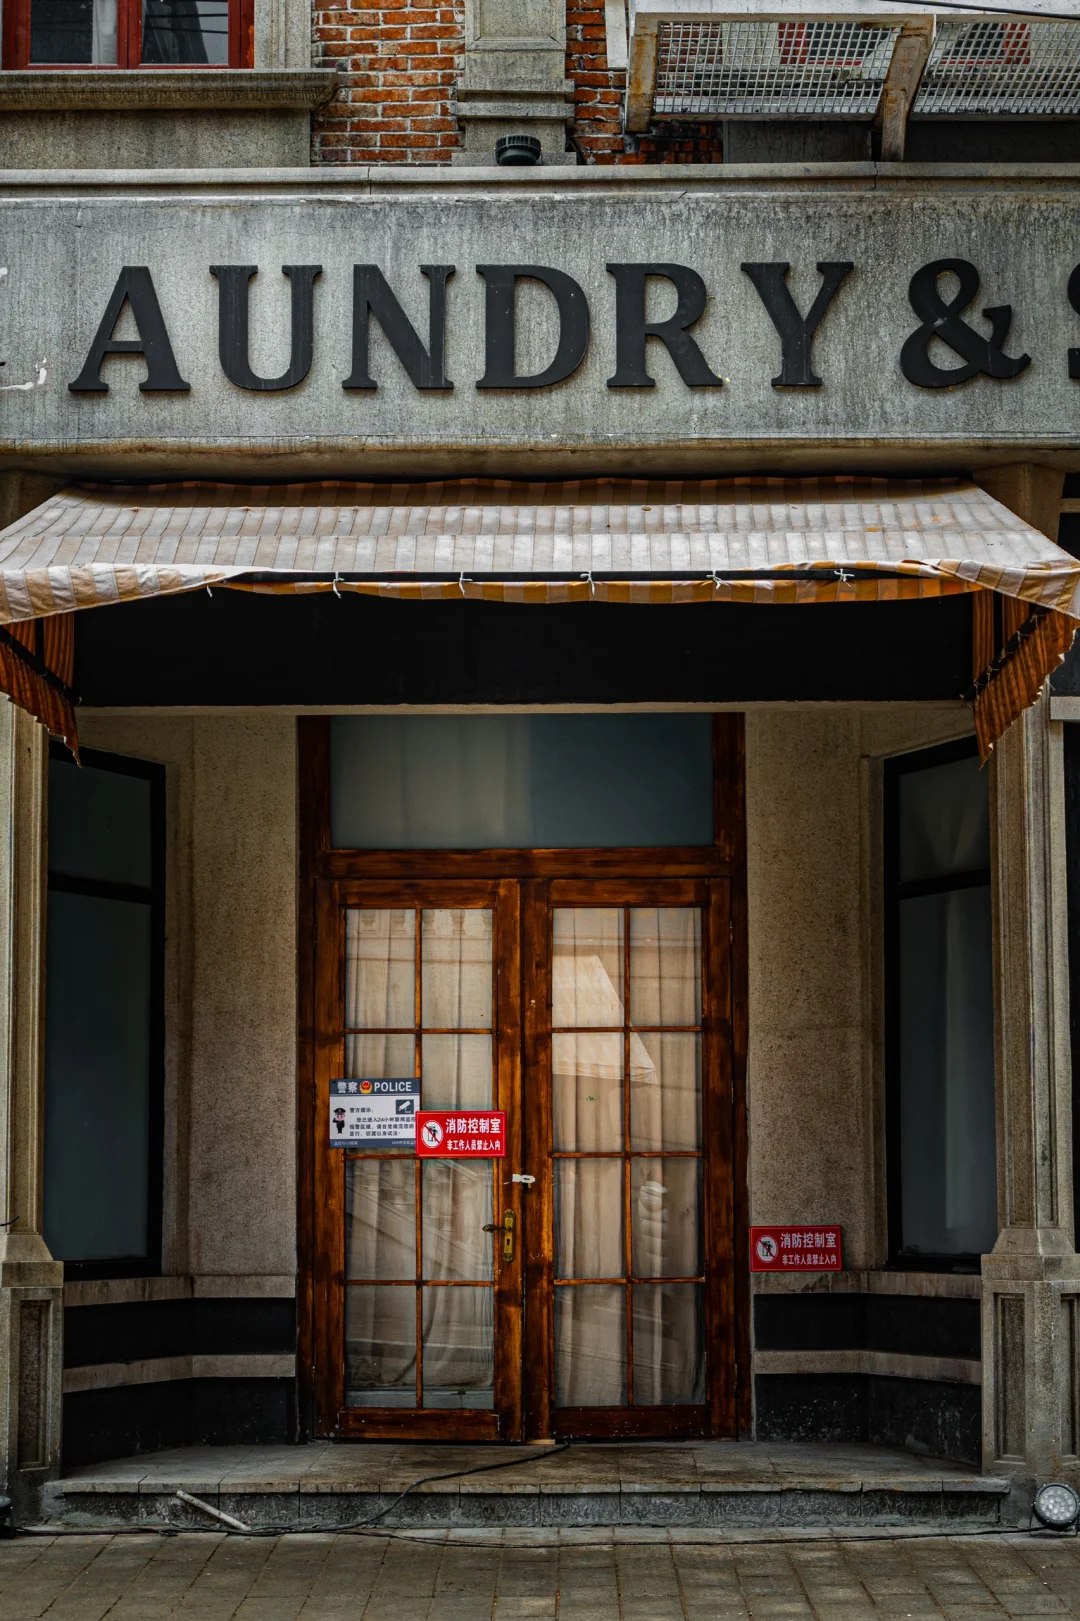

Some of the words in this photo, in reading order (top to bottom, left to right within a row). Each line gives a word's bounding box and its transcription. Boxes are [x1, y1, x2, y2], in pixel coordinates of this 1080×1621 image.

[68, 262, 854, 392] AUNDRY
[900, 258, 1032, 389] &
[337, 1081, 358, 1093] 警察
[374, 1081, 412, 1092] POLICE
[445, 1117, 501, 1134] 消防控制室
[446, 1139, 501, 1151] 非工作人员禁止入内
[780, 1232, 837, 1249] 消防控制室
[781, 1254, 837, 1265] 非工作人员禁止入内
